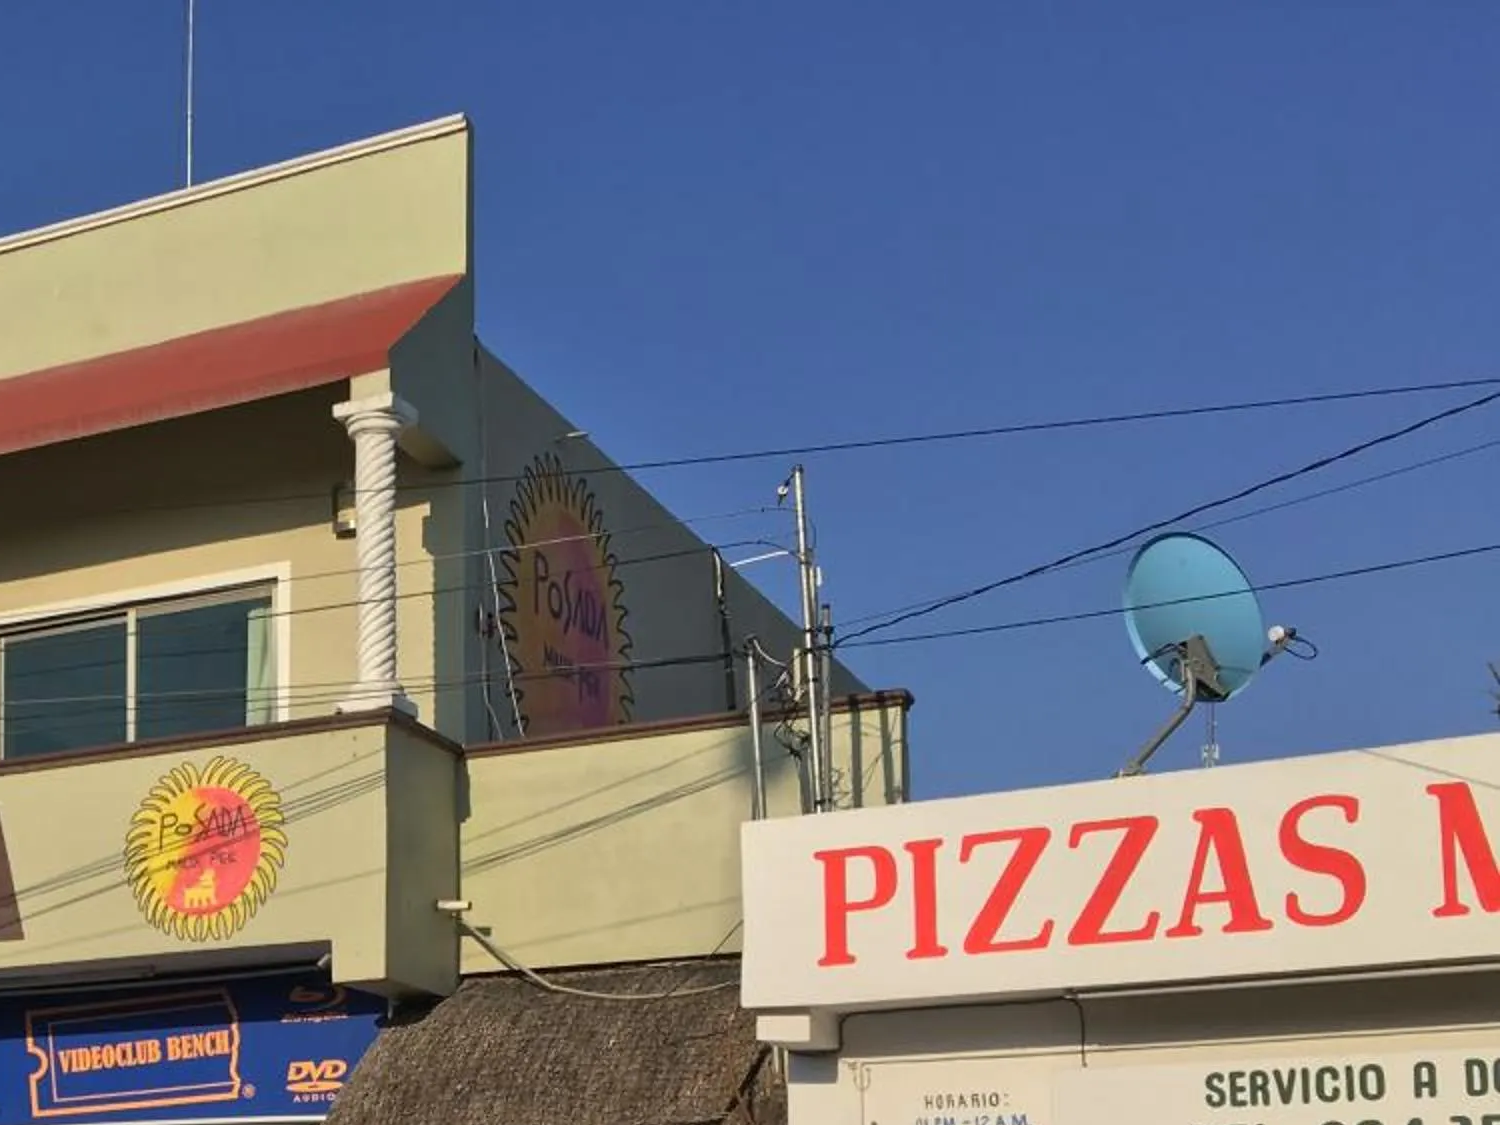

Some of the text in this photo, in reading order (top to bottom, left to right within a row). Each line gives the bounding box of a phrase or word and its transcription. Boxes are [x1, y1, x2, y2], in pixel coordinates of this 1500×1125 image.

[813, 794, 1367, 968] PIZZAS
[58, 1029, 230, 1075] VIDEOCLUB BENCH
[286, 1059, 348, 1083] DVD
[1204, 1057, 1500, 1108] SERVICIO A D
